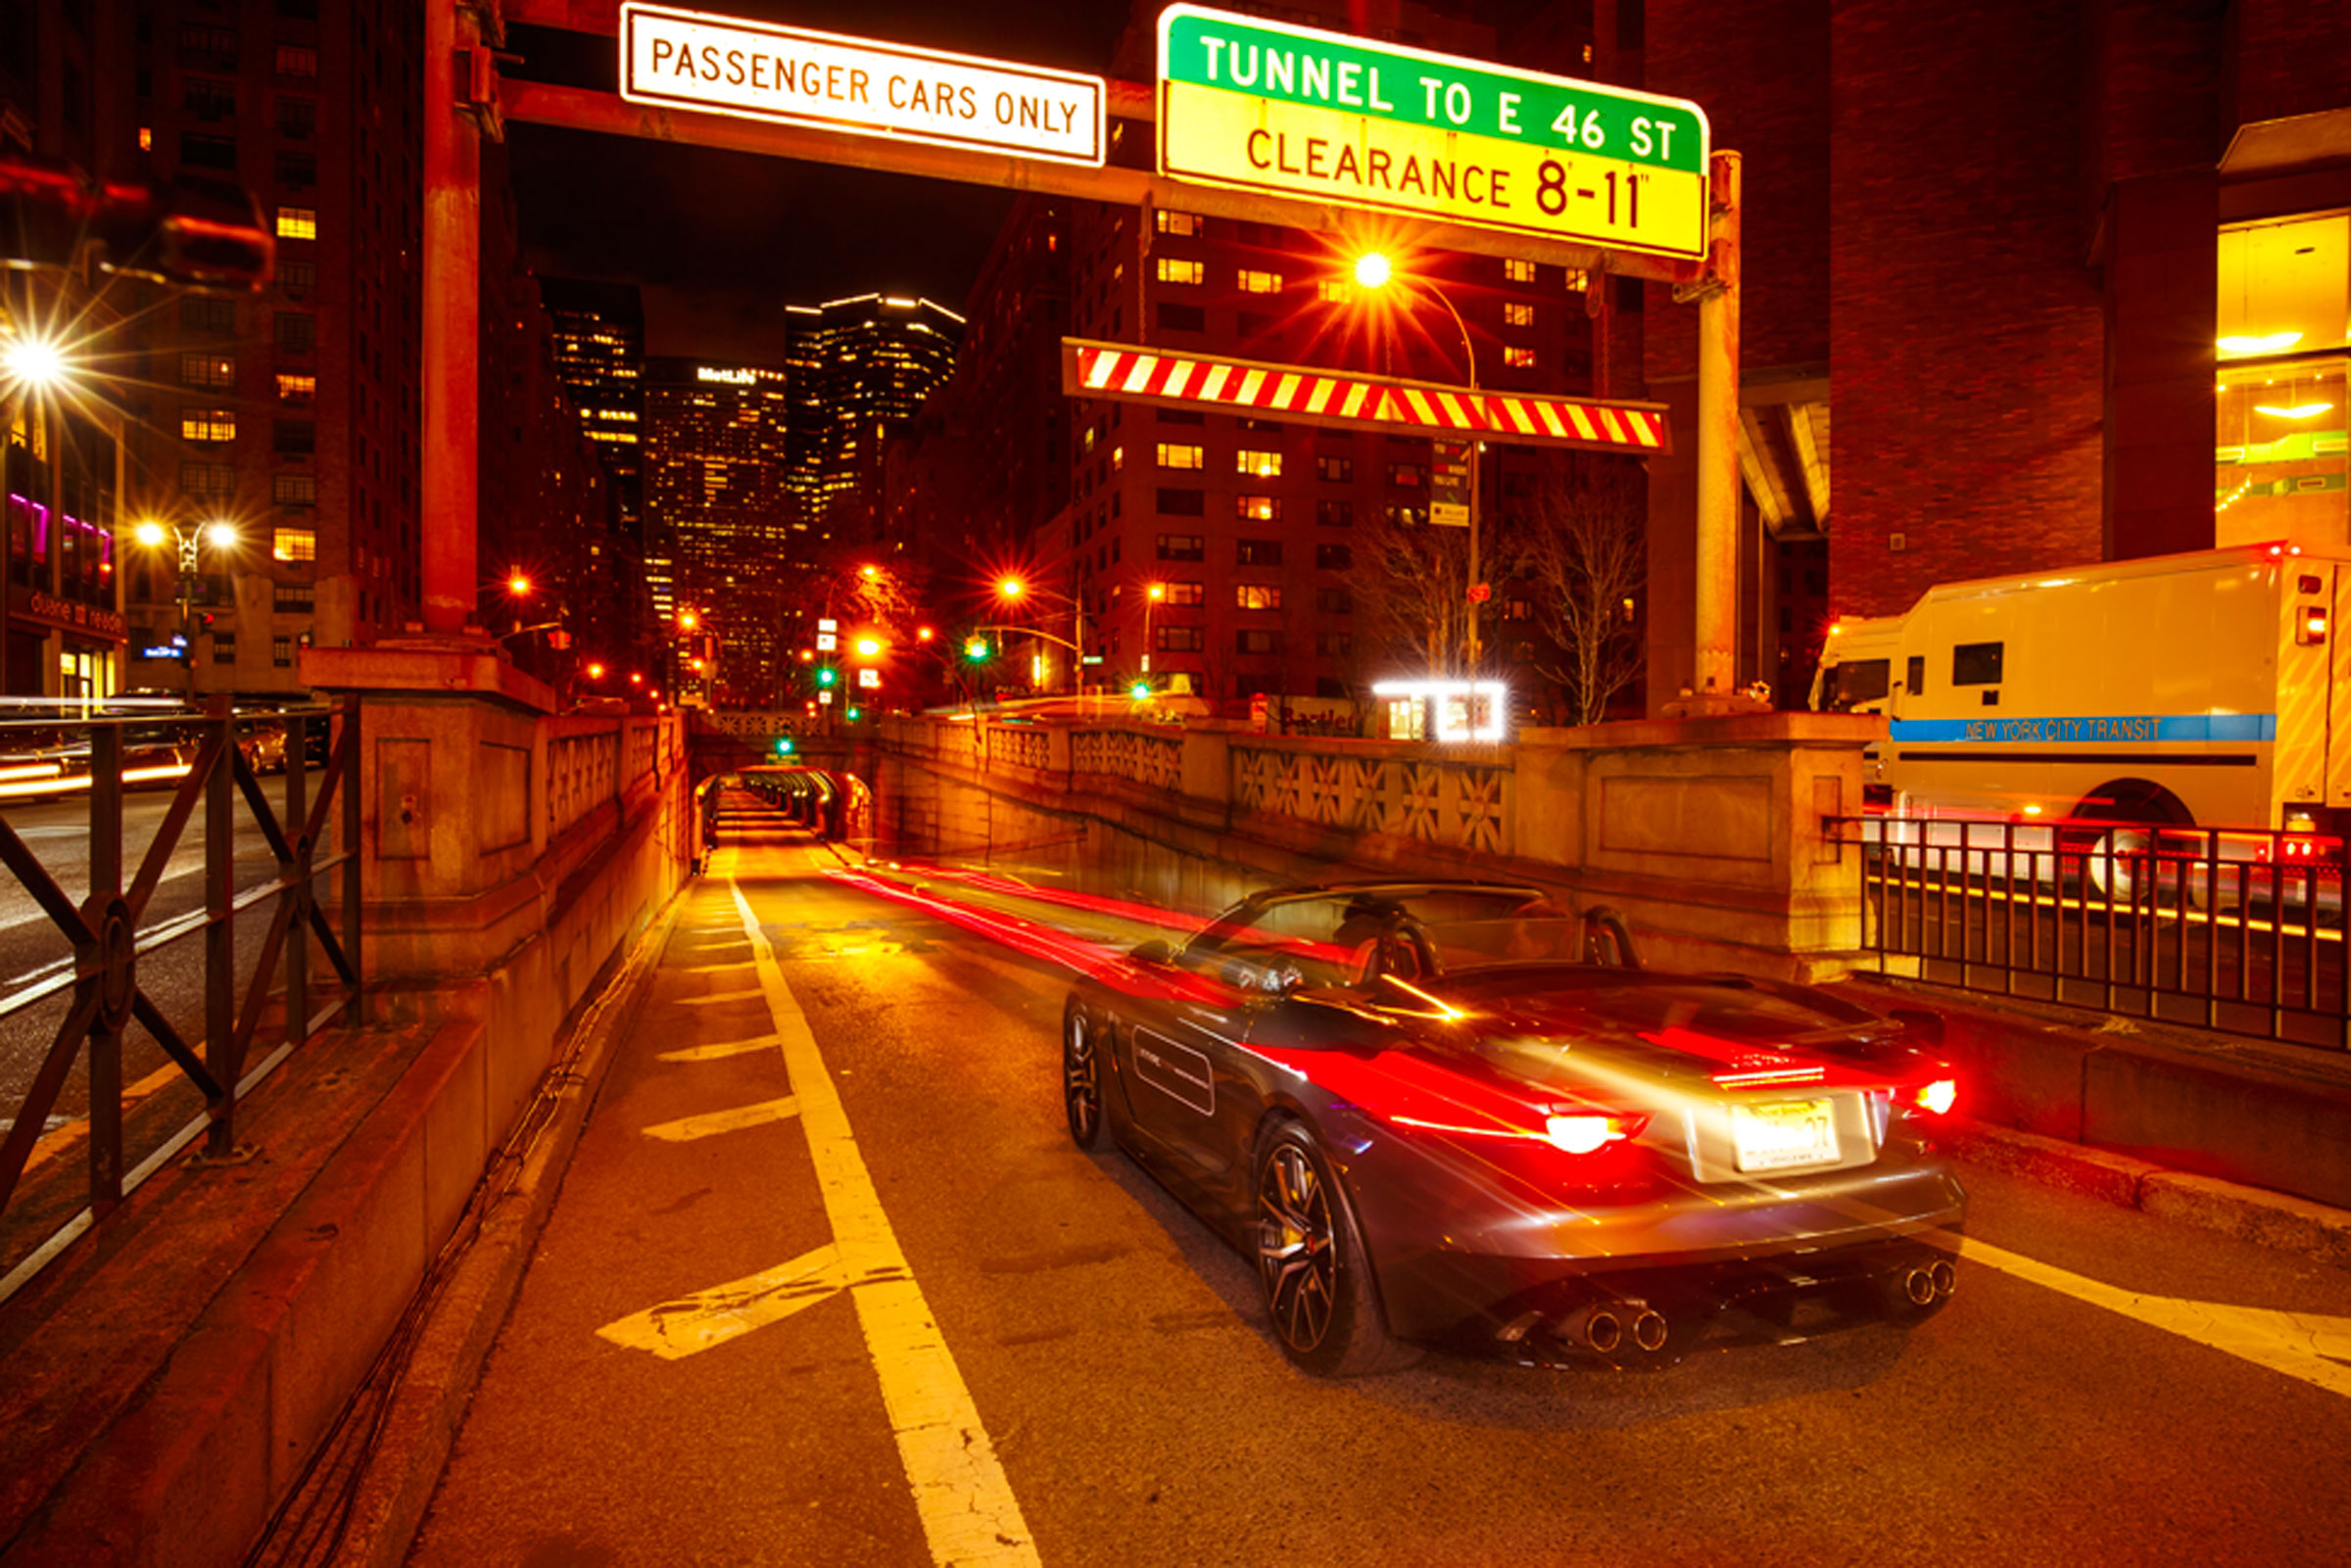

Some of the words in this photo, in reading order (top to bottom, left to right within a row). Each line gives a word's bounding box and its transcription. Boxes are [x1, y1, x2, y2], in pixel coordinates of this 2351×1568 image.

[651, 38, 869, 103] PASSENGER
[888, 75, 978, 119] CARS
[995, 91, 1078, 134] ONLY
[1200, 36, 1393, 112] TUNNEL
[1418, 76, 1471, 125] TO
[1499, 91, 1522, 134] E
[1551, 104, 1606, 149] 46
[1630, 117, 1677, 161] ST
[1247, 128, 1511, 209] CLEARANCE
[1965, 721, 1997, 740] NEW
[2002, 720, 2041, 740] YORK
[2045, 719, 2082, 740] CITY
[2087, 717, 2163, 739] TRANSIT
